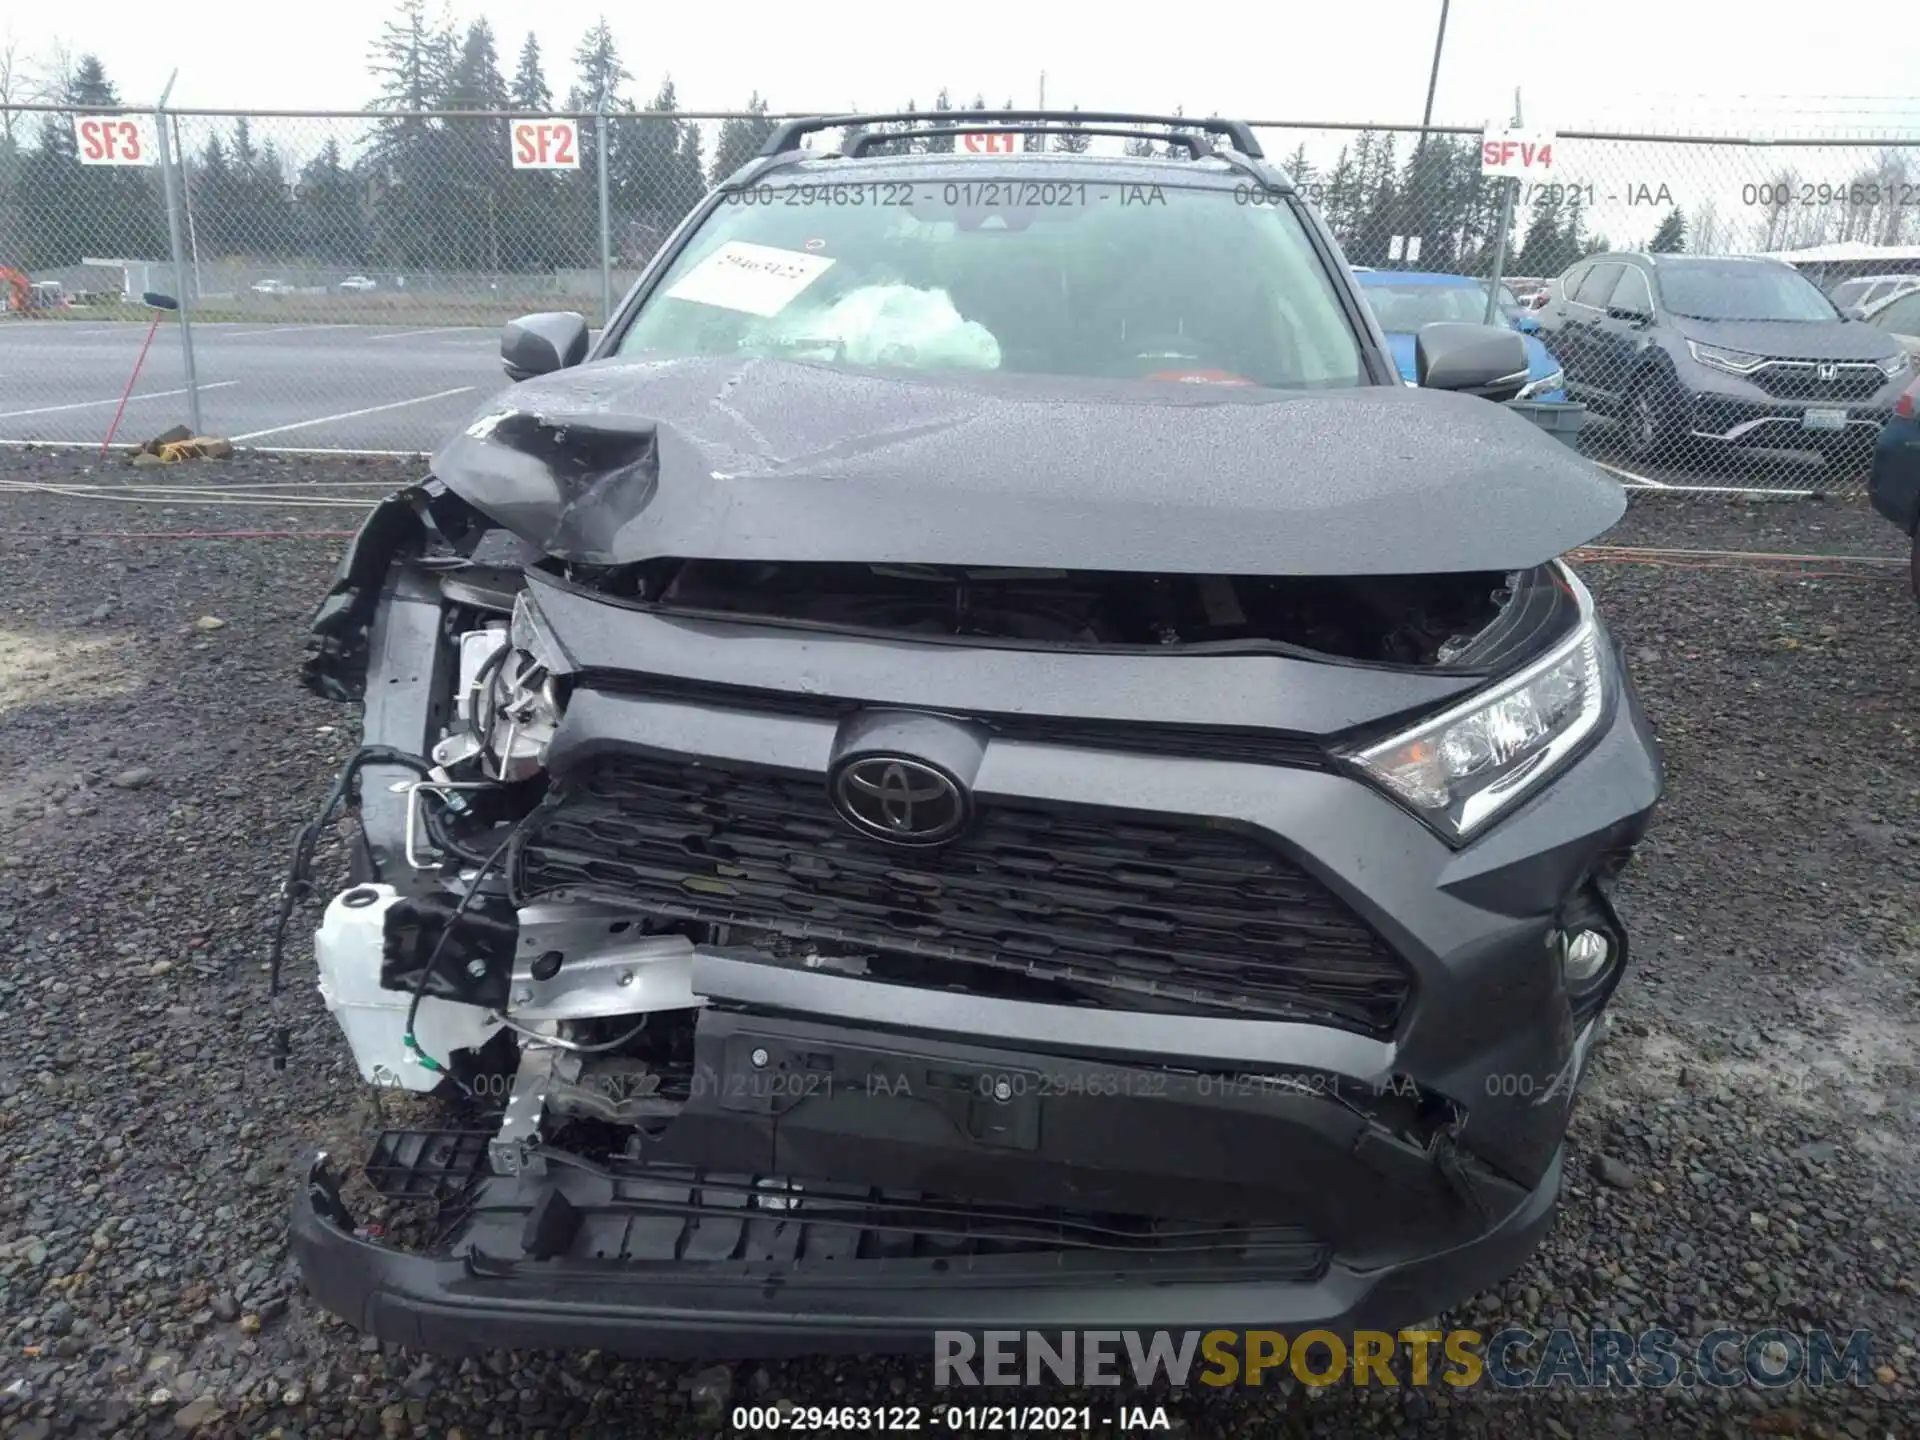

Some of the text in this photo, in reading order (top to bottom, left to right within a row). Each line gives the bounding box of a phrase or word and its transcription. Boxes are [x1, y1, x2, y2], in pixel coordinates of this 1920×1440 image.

[81, 121, 141, 161] SF3
[515, 124, 574, 164] SF2
[1483, 141, 1553, 169] SFV4
